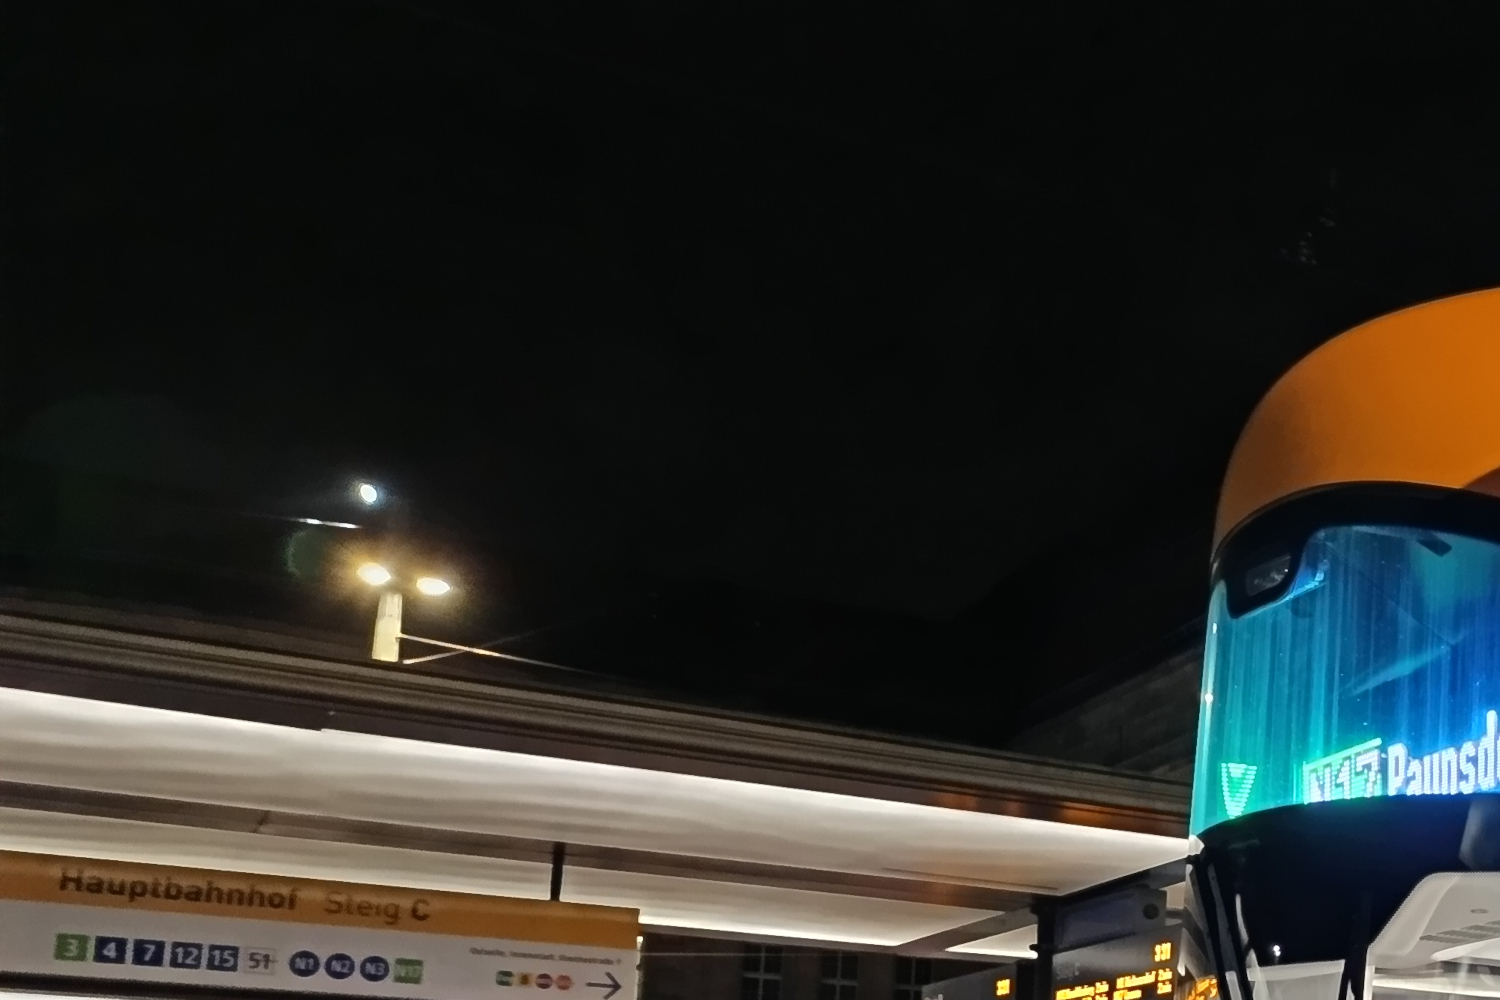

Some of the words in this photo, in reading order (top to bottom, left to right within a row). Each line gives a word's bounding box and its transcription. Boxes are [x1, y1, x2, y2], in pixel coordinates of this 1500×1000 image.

[1310, 749, 1381, 803] N17
[59, 870, 298, 911] Hauptbahnhof
[324, 890, 400, 926] Steig
[410, 898, 430, 922] C
[64, 939, 79, 957] 3
[102, 941, 118, 959] 4
[142, 944, 156, 961] 7
[175, 946, 199, 965] 12
[210, 949, 236, 968] 15
[293, 957, 315, 971] N1
[330, 959, 351, 973] N2
[364, 962, 386, 976] N3
